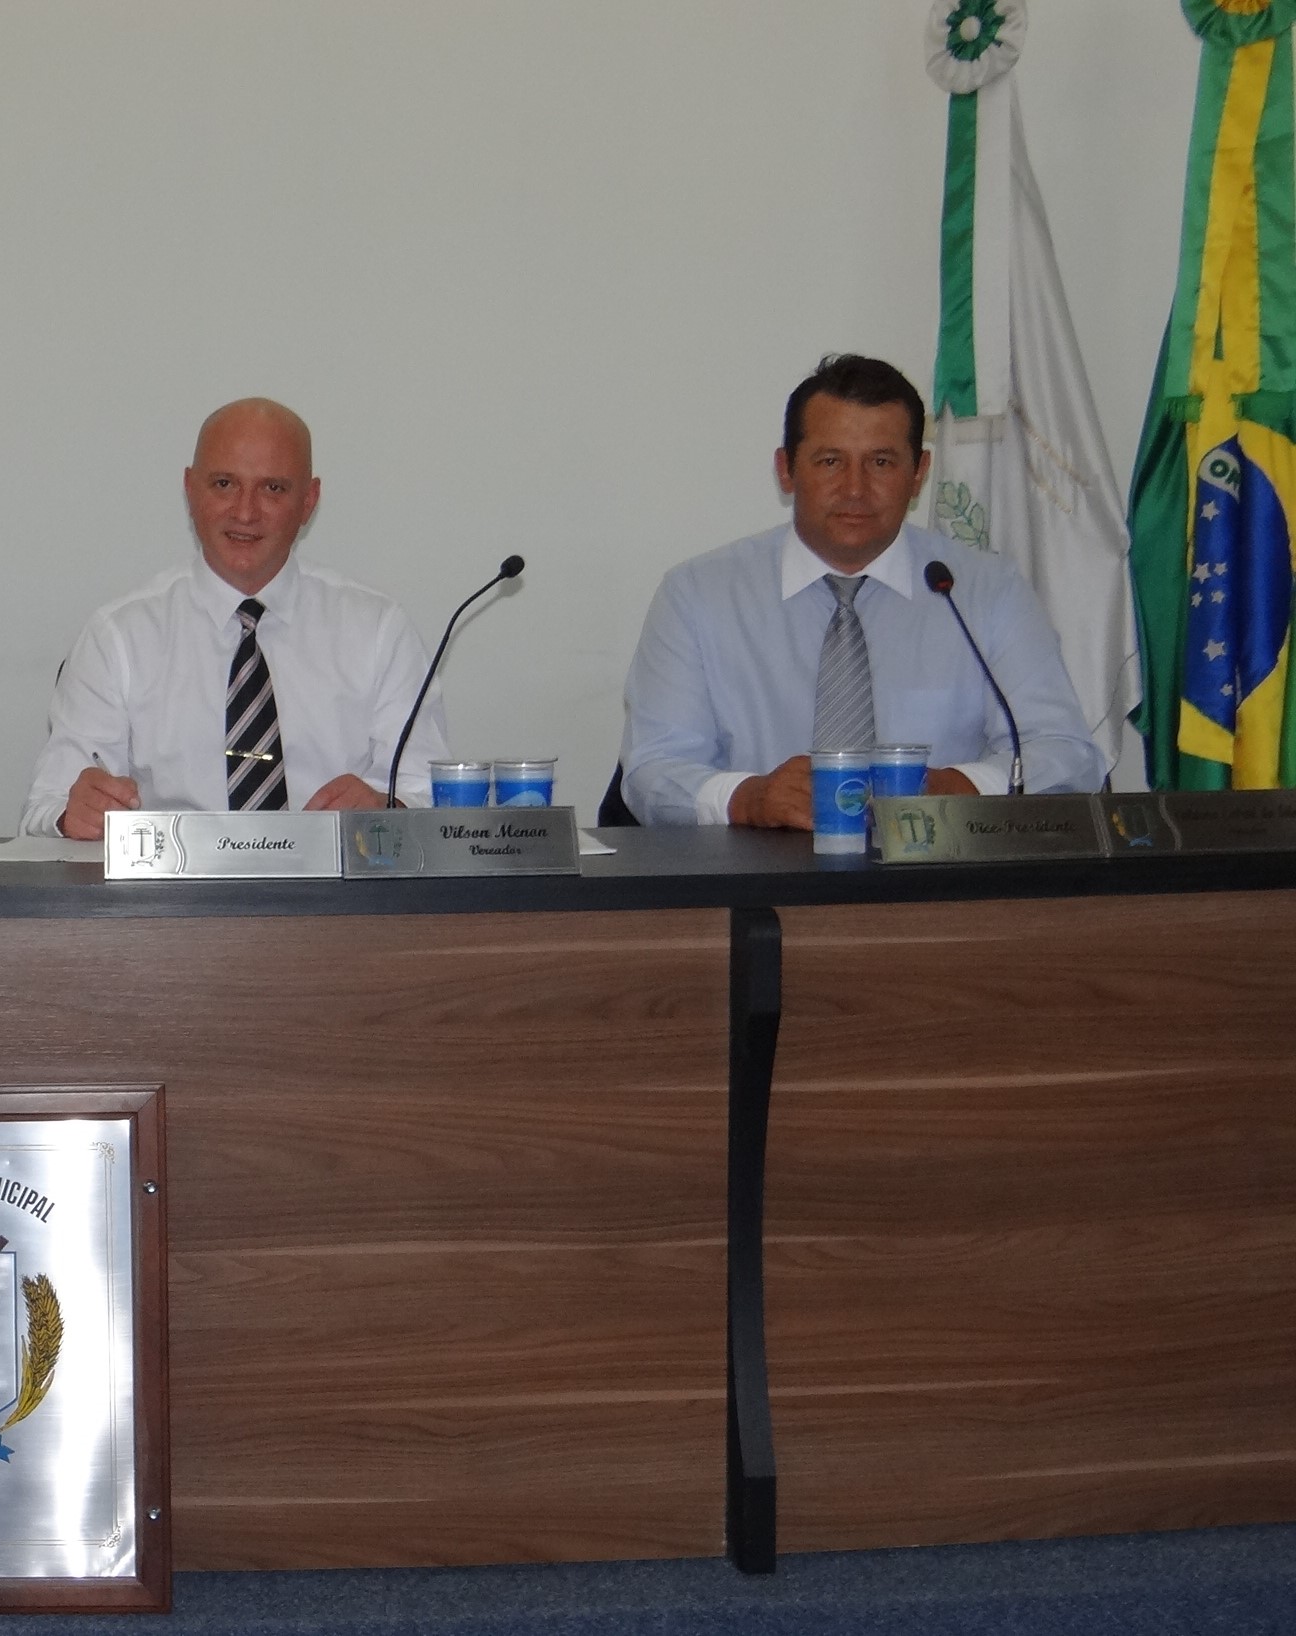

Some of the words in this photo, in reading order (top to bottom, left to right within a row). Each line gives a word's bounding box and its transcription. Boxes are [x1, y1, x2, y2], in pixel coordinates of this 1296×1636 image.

[439, 825, 490, 839] Vilson
[216, 836, 297, 850] Presidente
[469, 844, 522, 855] Vereador
